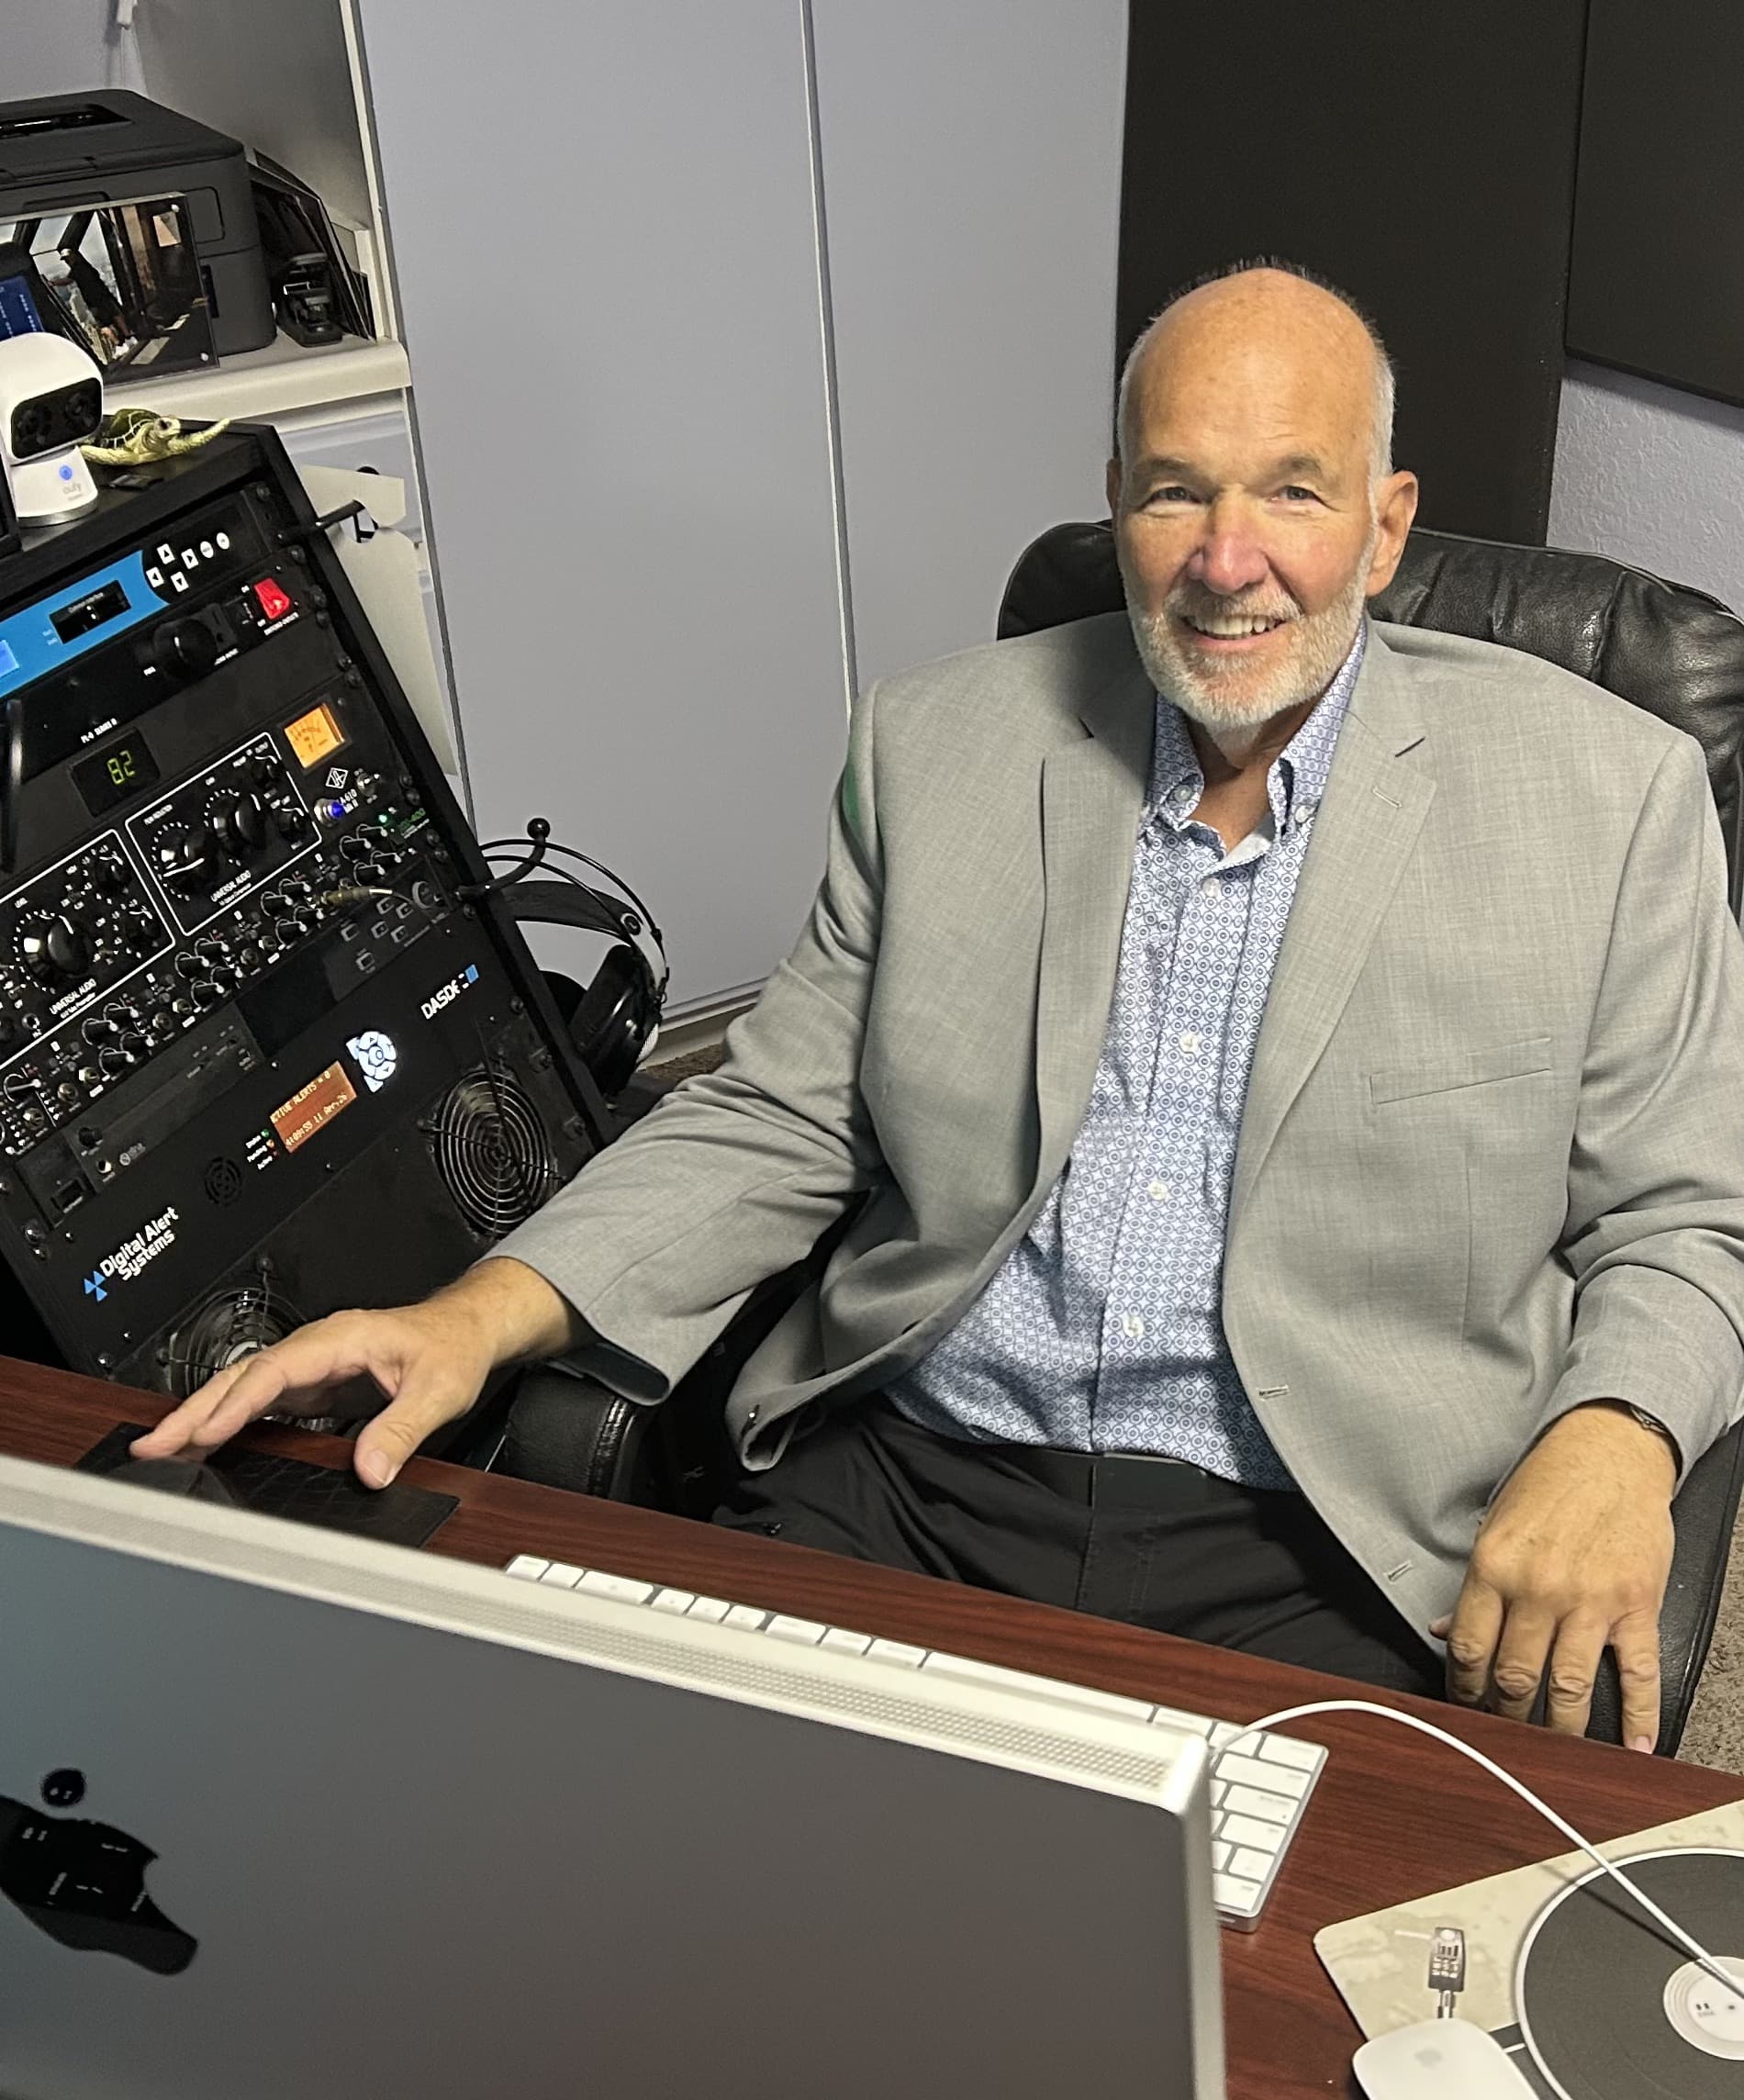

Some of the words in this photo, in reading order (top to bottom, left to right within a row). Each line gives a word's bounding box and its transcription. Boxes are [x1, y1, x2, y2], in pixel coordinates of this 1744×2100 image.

[106, 749, 136, 785] 82
[210, 880, 237, 902] UNIVERSAL
[49, 990, 81, 1014] UNIVERSAL
[78, 977, 96, 996] AUDIO
[292, 1083, 318, 1105] ALERTS
[99, 1232, 146, 1278] Digital
[144, 1206, 179, 1242] Alert
[117, 1229, 175, 1281] Systems
